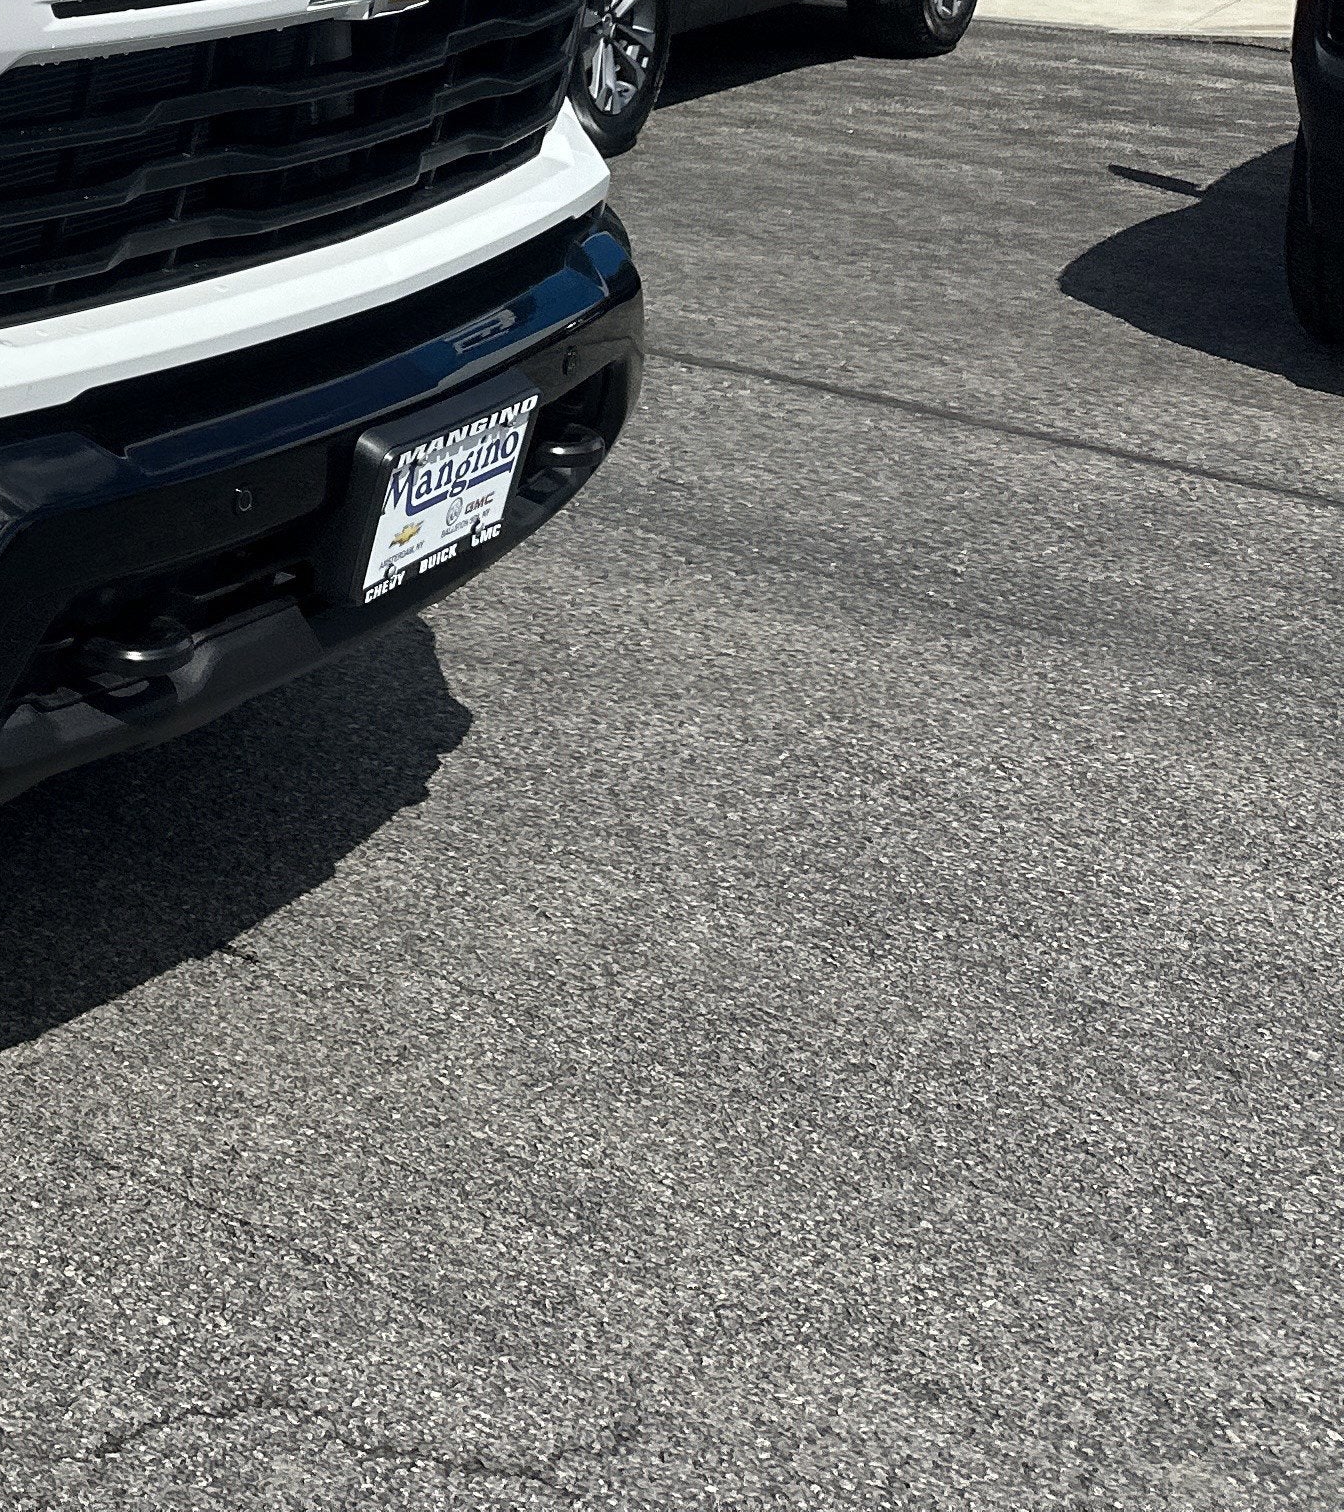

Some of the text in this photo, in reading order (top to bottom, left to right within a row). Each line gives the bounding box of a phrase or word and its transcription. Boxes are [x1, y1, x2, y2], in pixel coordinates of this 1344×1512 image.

[398, 394, 539, 469] MANGINO
[388, 431, 519, 516] Mangino
[419, 543, 458, 574] BUICK
